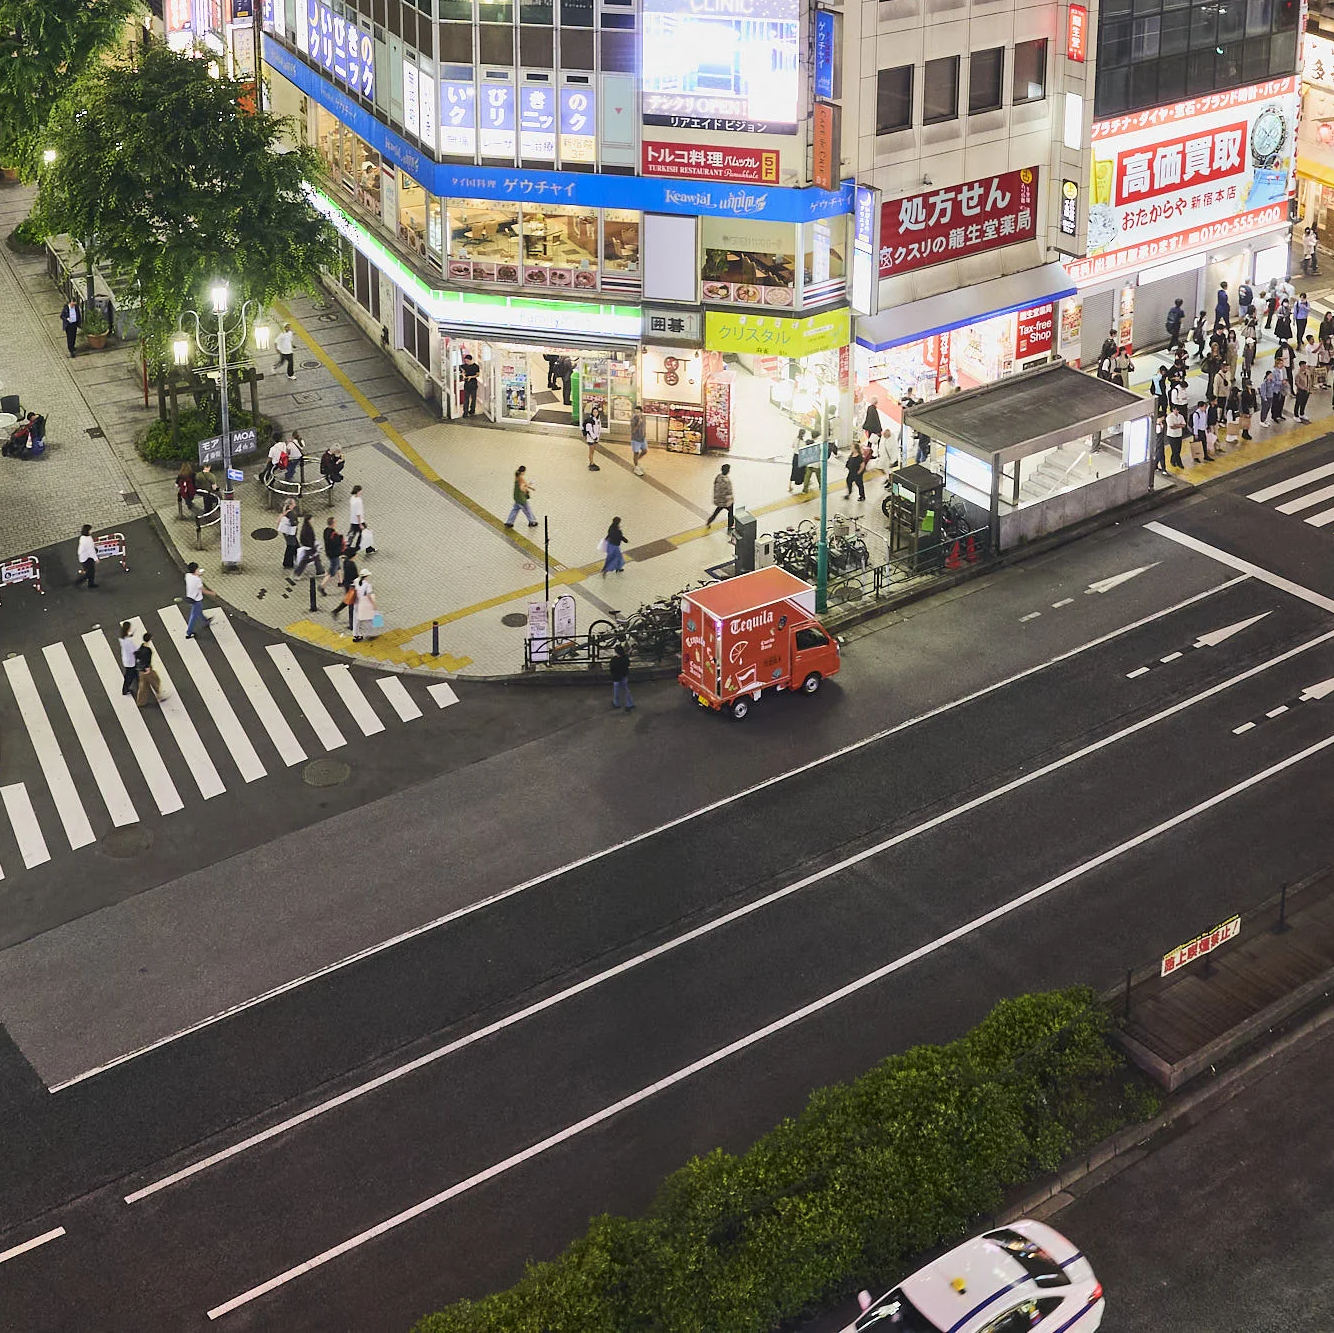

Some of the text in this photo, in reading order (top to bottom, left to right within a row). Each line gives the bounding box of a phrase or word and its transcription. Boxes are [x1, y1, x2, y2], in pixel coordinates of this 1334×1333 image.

[321, 6, 374, 65] いびきの
[817, 22, 826, 69] ゲウチャイ
[310, 32, 375, 98] クリニック
[447, 86, 589, 112] いびきの
[448, 106, 588, 132] クリニック
[670, 117, 768, 133] リアエイド ビジョン
[647, 146, 774, 179] トルコ料理 パムッカレ 5F
[648, 164, 679, 174] TURKISH
[679, 166, 724, 177] RESTAURANT
[1121, 128, 1243, 199] 高価買取
[502, 177, 576, 197] ゲウチャイ
[898, 177, 1012, 235] 処方せん
[1121, 185, 1237, 232] おたからや 新宿本店
[1199, 206, 1280, 241] 0120-555-600
[893, 209, 1032, 265] クスリの龍生堂薬局
[650, 315, 685, 333] 囲碁
[717, 324, 791, 346] クリスタル
[1018, 319, 1052, 336] Tax-free
[1029, 329, 1051, 345] Shop
[202, 438, 220, 450] モア
[233, 431, 256, 442] MOA
[729, 609, 774, 635] Tequila
